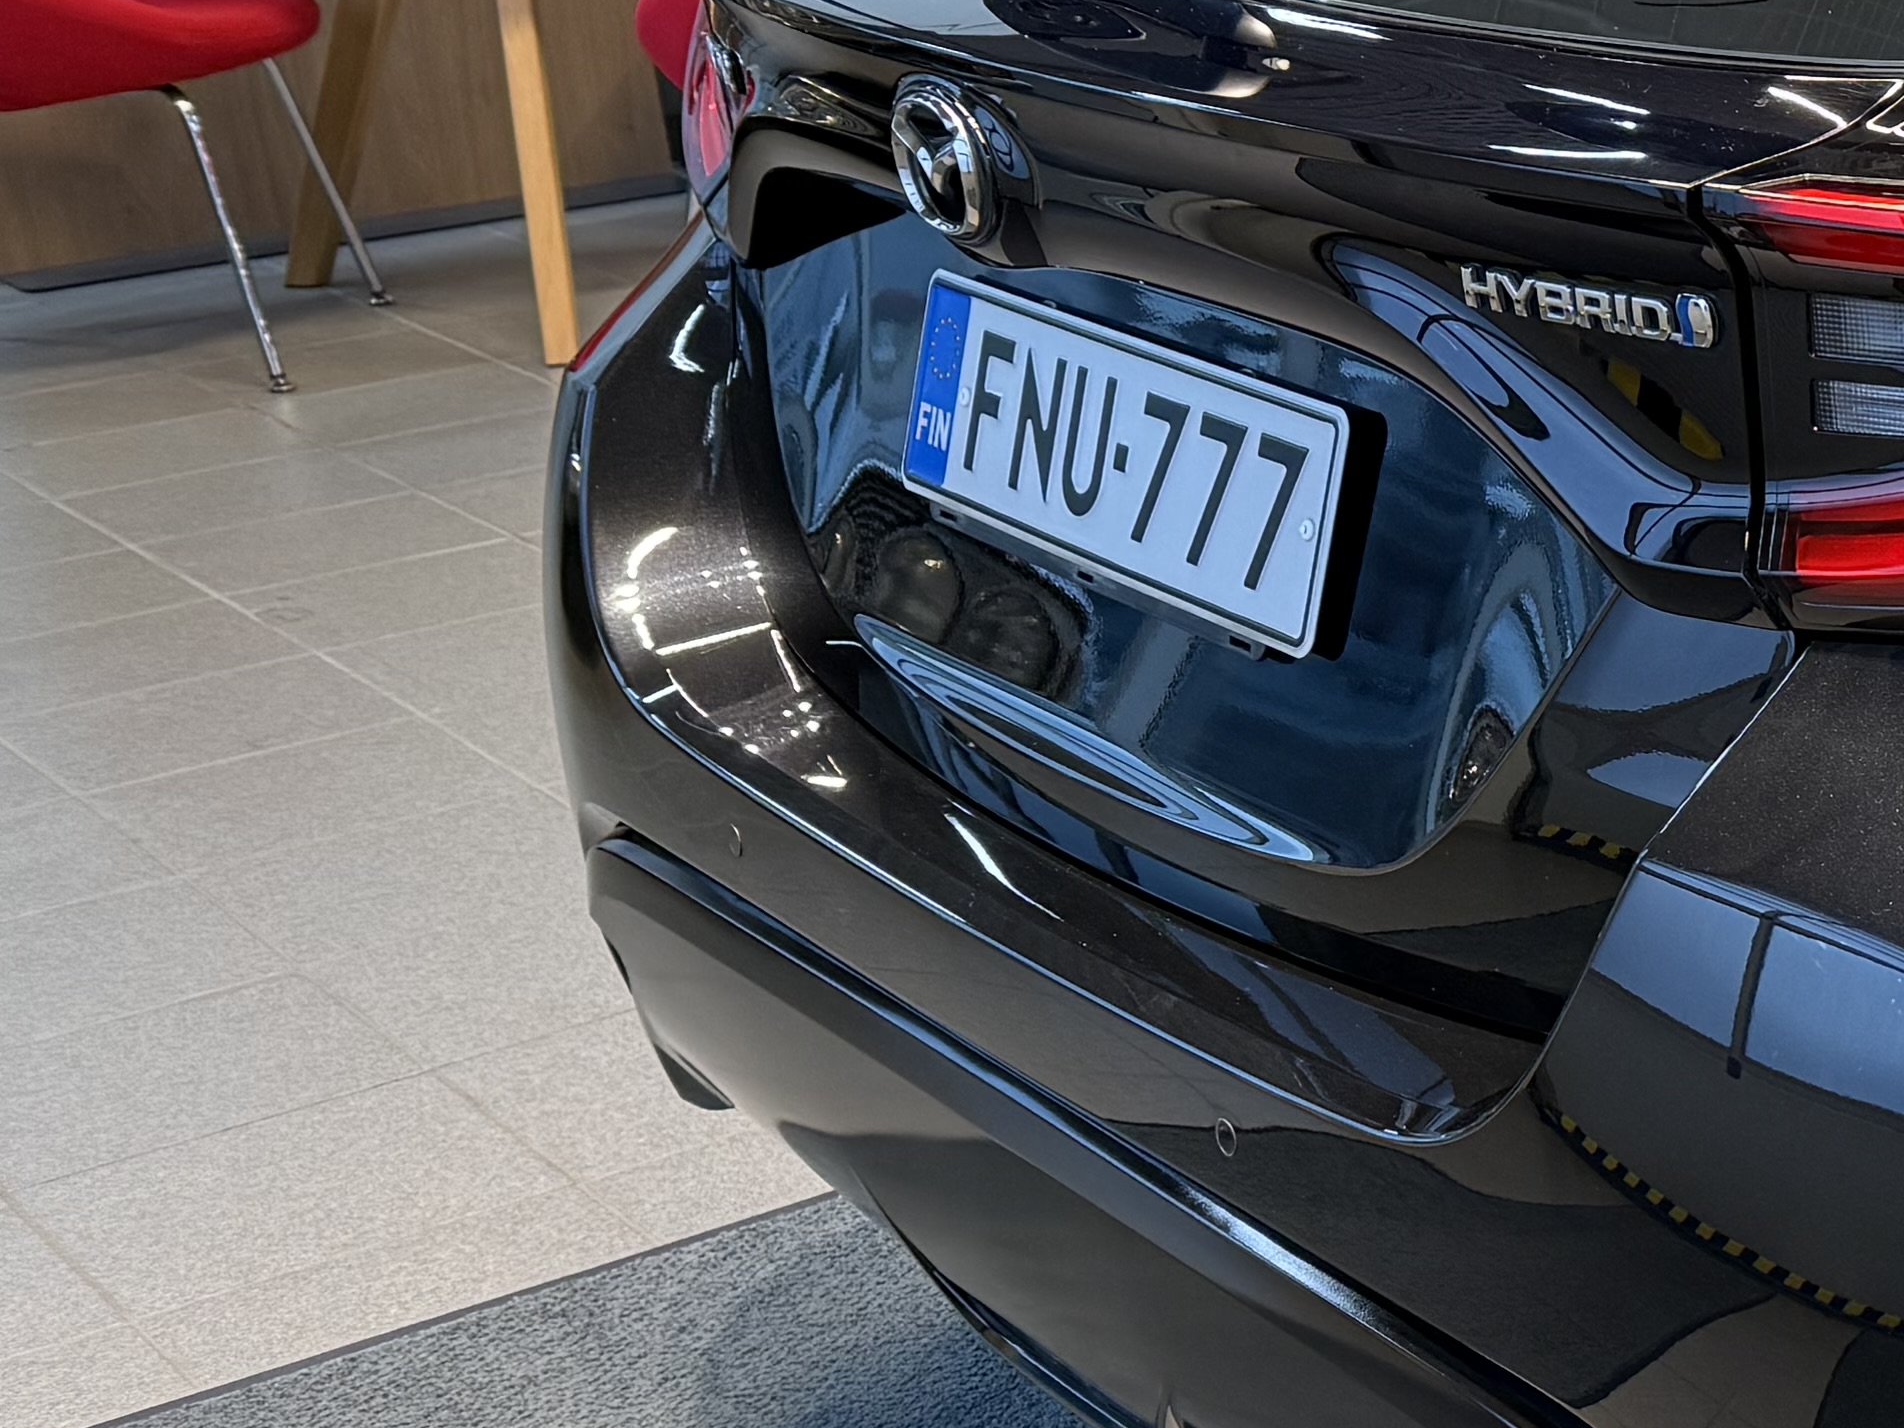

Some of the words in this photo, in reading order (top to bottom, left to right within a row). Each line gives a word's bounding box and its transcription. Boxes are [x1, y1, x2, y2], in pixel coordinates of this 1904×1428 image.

[1461, 263, 1674, 342] HYBRID
[915, 401, 951, 452] FIN
[963, 329, 1310, 592] FNU-777
